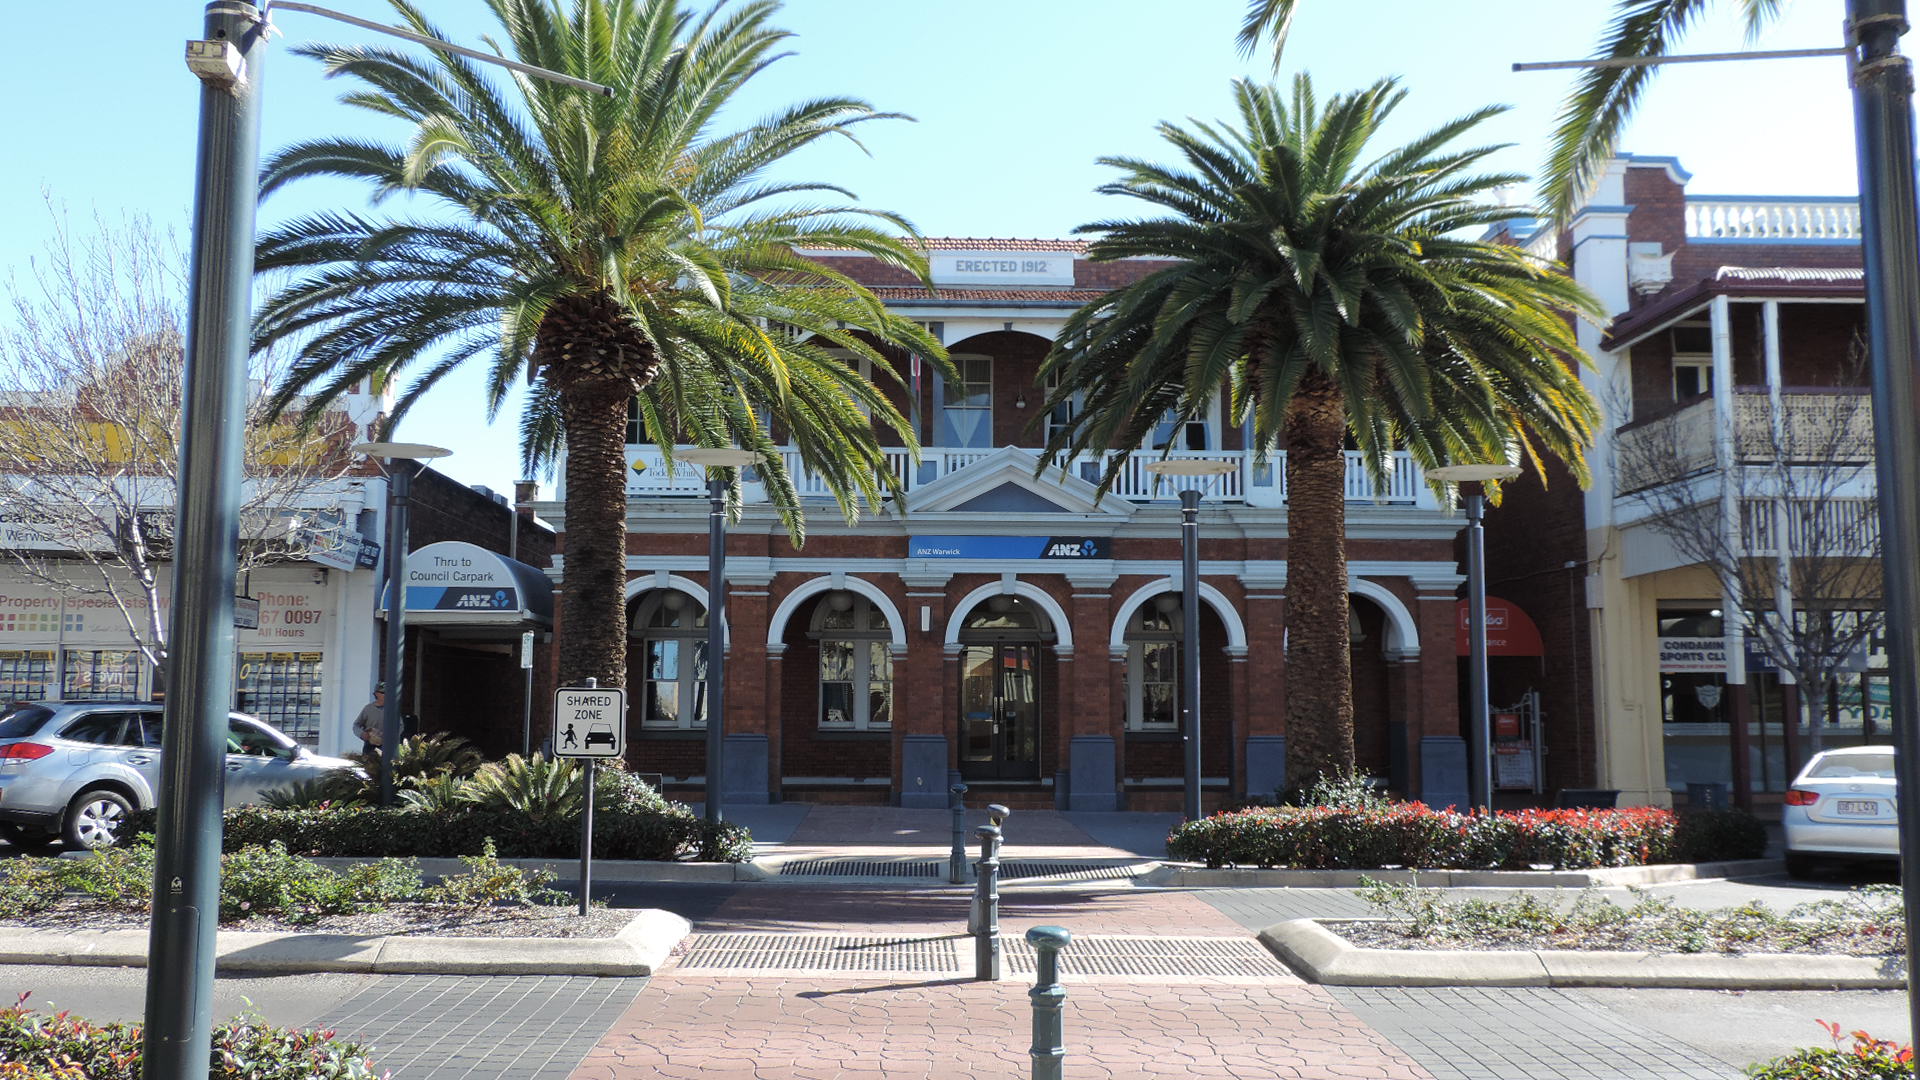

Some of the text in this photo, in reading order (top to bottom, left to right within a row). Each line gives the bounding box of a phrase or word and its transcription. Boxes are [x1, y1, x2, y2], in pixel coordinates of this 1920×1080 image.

[956, 260, 1047, 273] ERECTED 1912
[1048, 544, 1081, 556] ANZ
[434, 556, 472, 567] Thru to
[410, 570, 494, 583] Council Carpark
[0, 595, 60, 609] Property
[256, 591, 309, 607] Phone:
[456, 594, 491, 607] ANZ
[260, 609, 280, 625] 67
[284, 609, 322, 625] 0097
[257, 627, 305, 637] All Hours
[1663, 640, 1725, 650] CONDAMIN
[1659, 651, 1705, 662] SPORTS
[566, 696, 612, 707] SHARED
[574, 709, 603, 720] ZONE
